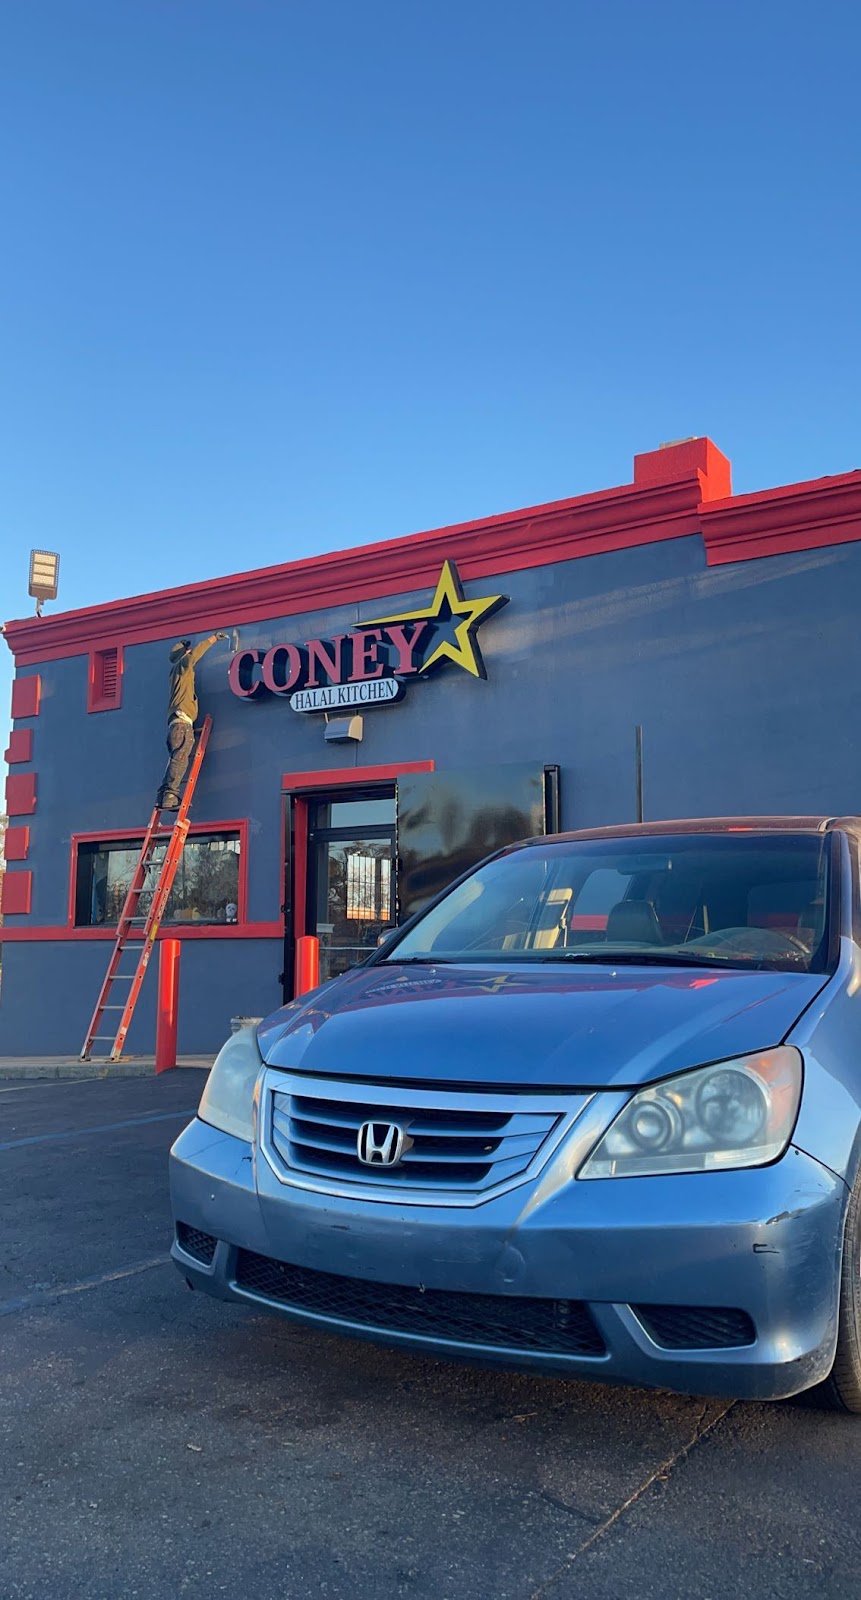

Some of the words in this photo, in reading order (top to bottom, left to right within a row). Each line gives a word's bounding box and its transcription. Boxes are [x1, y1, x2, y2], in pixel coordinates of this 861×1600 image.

[228, 621, 428, 698] CONEY
[295, 689, 336, 710] HALAL
[338, 680, 395, 704] KITCHEN
